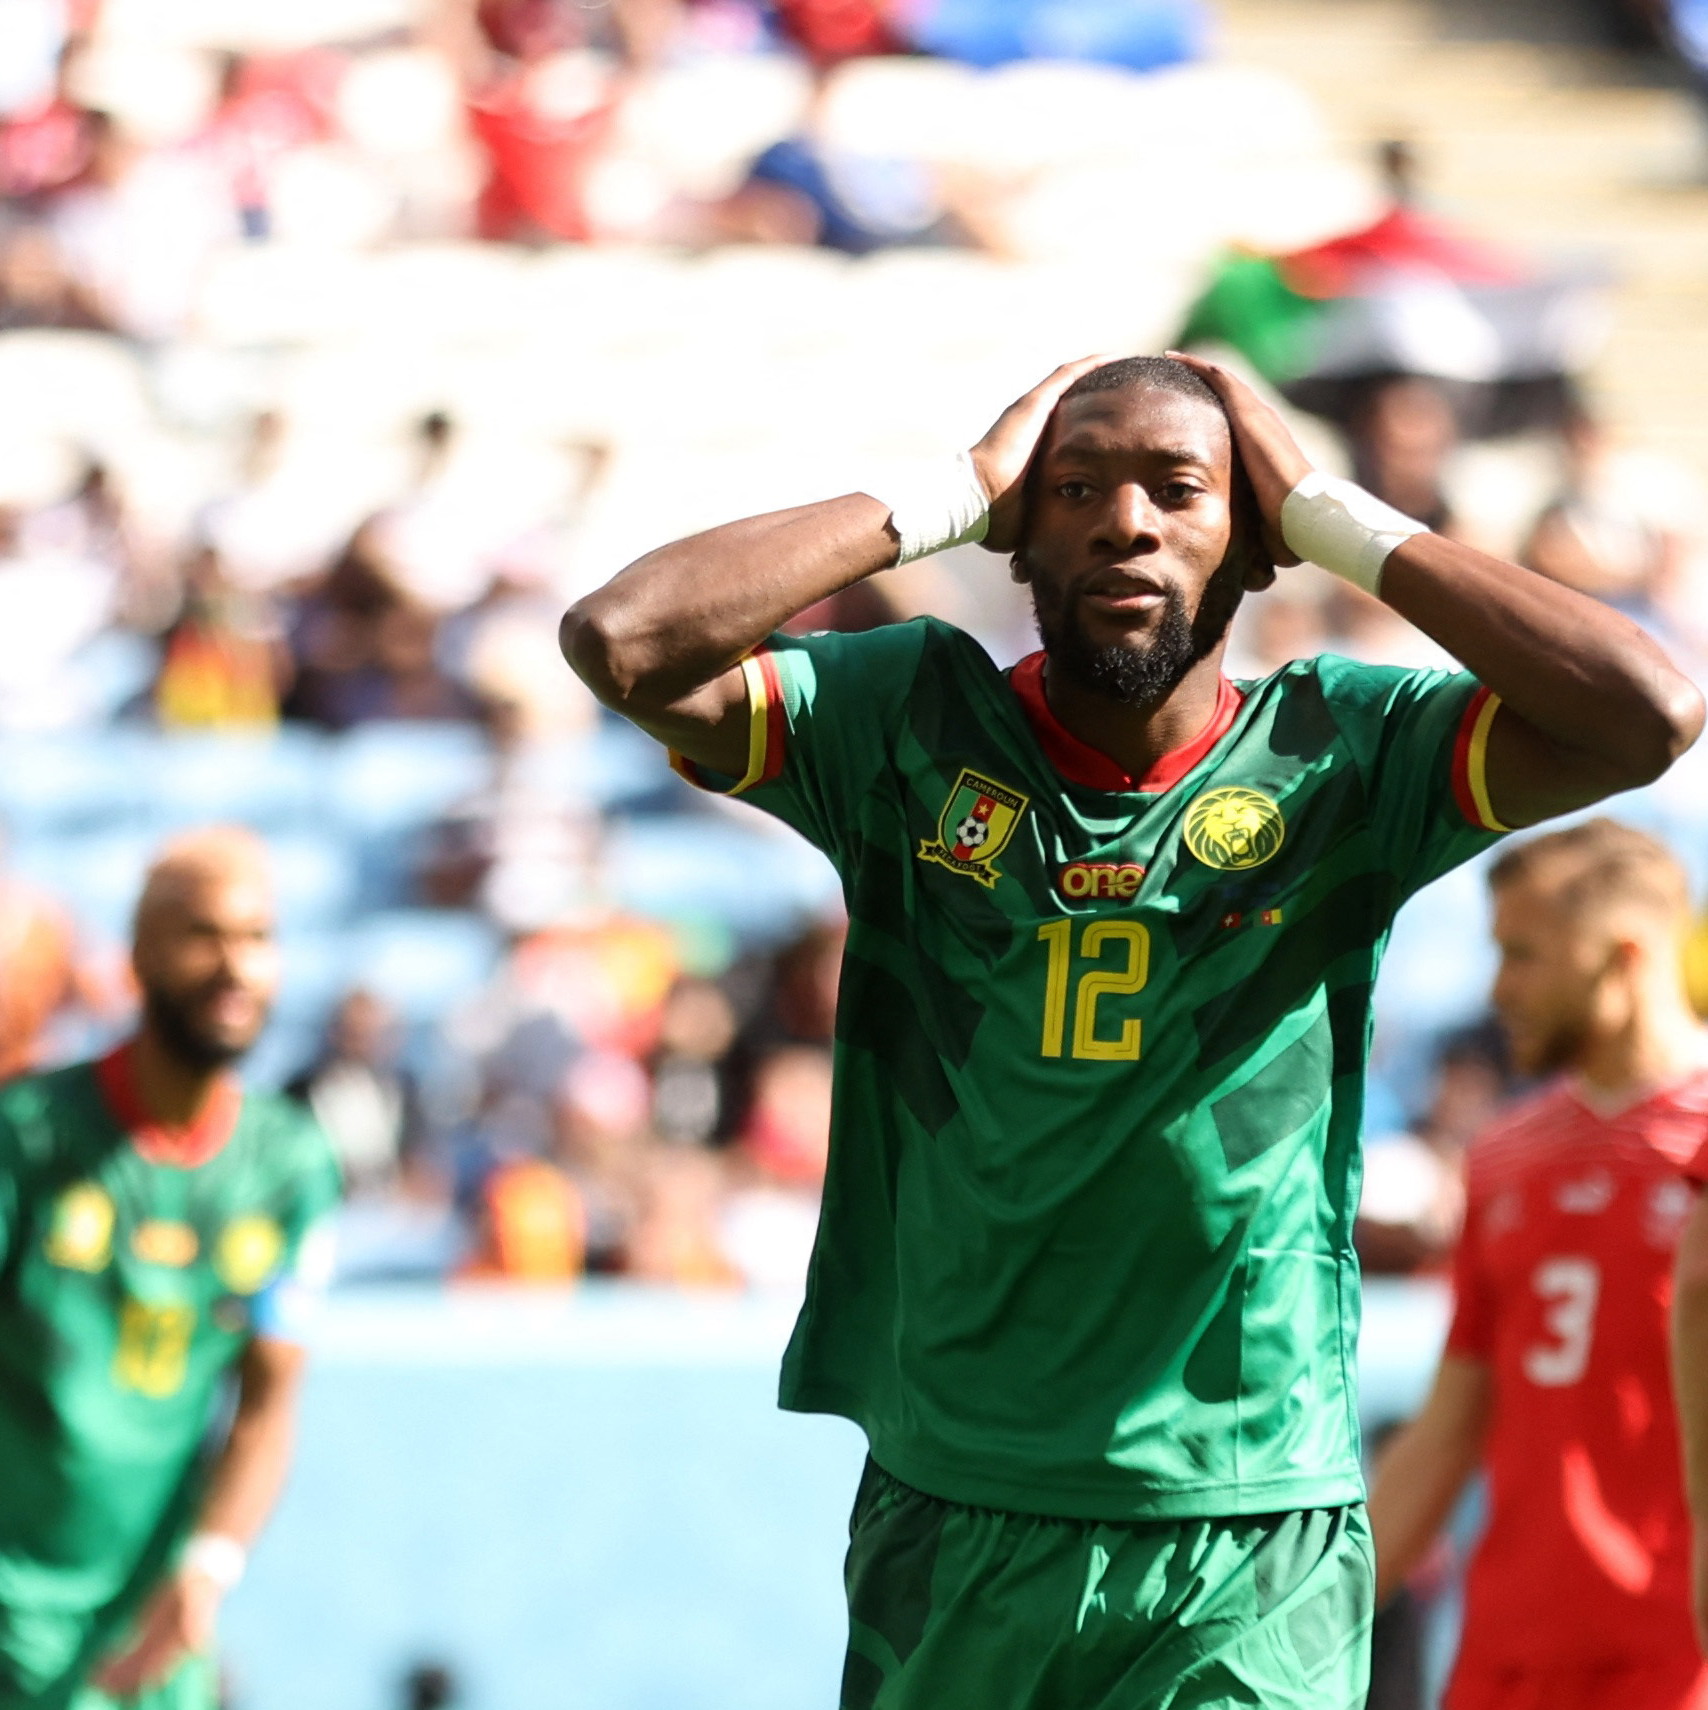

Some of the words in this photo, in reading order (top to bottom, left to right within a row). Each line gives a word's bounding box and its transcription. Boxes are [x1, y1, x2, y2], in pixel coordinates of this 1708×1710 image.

[965, 777, 1019, 808] CAMEROUN
[1061, 865, 1144, 898] one
[1037, 918, 1151, 1061] 12
[1522, 1256, 1601, 1387] 3
